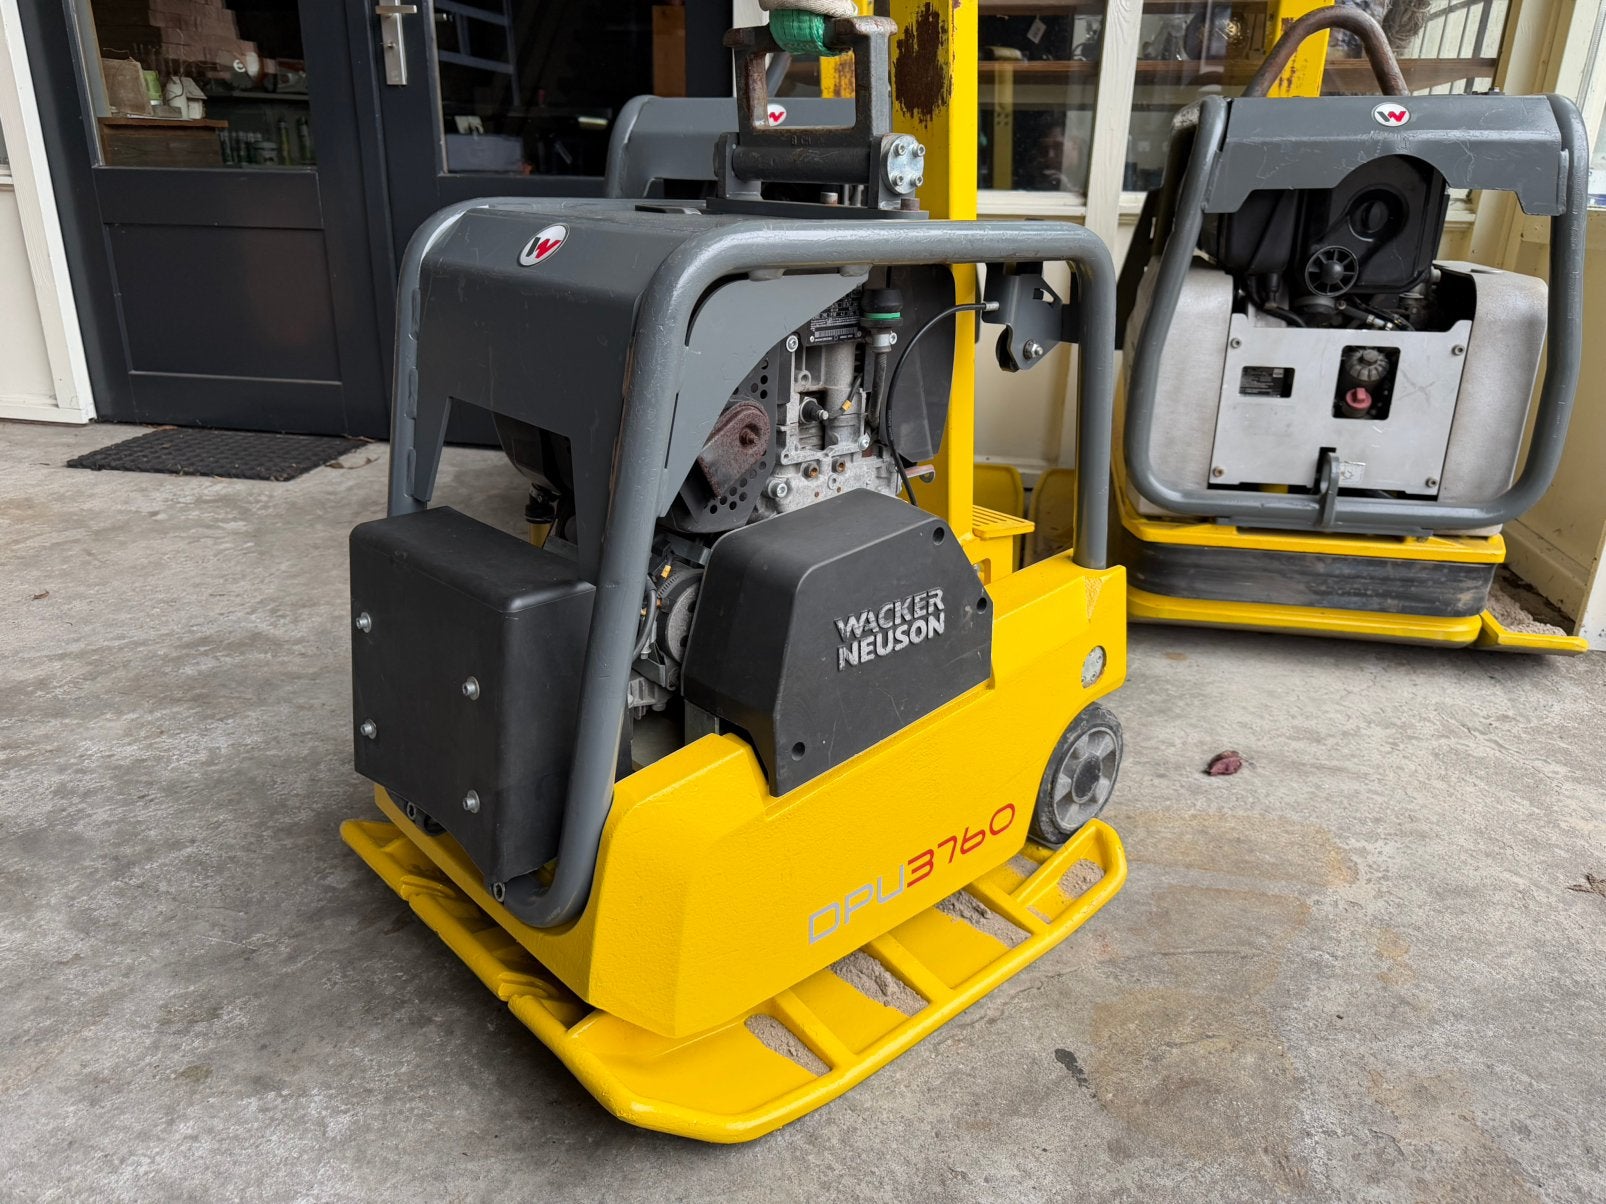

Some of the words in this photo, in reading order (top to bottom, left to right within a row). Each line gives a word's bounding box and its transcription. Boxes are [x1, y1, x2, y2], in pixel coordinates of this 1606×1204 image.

[1376, 110, 1406, 122] W
[525, 236, 561, 259] W
[834, 587, 945, 641] WACKER
[837, 611, 945, 672] NEUSON
